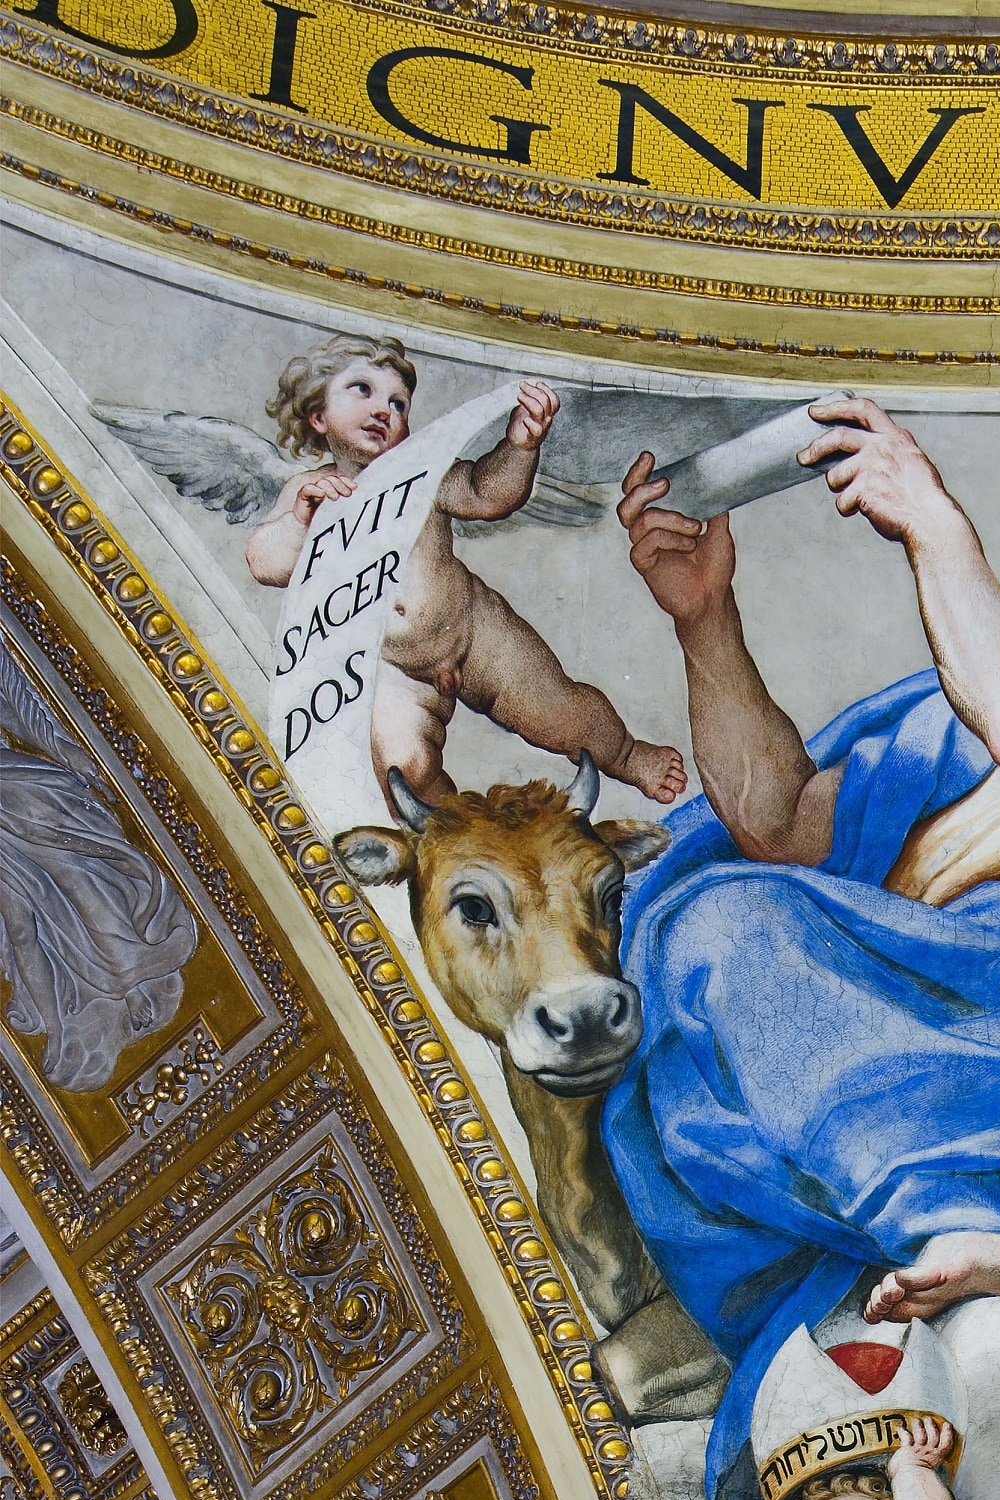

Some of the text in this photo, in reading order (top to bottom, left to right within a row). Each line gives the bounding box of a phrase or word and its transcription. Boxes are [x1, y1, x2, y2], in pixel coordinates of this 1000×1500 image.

[301, 471, 428, 585] FVIT
[276, 550, 401, 677] SACER
[284, 650, 366, 763] DOS
